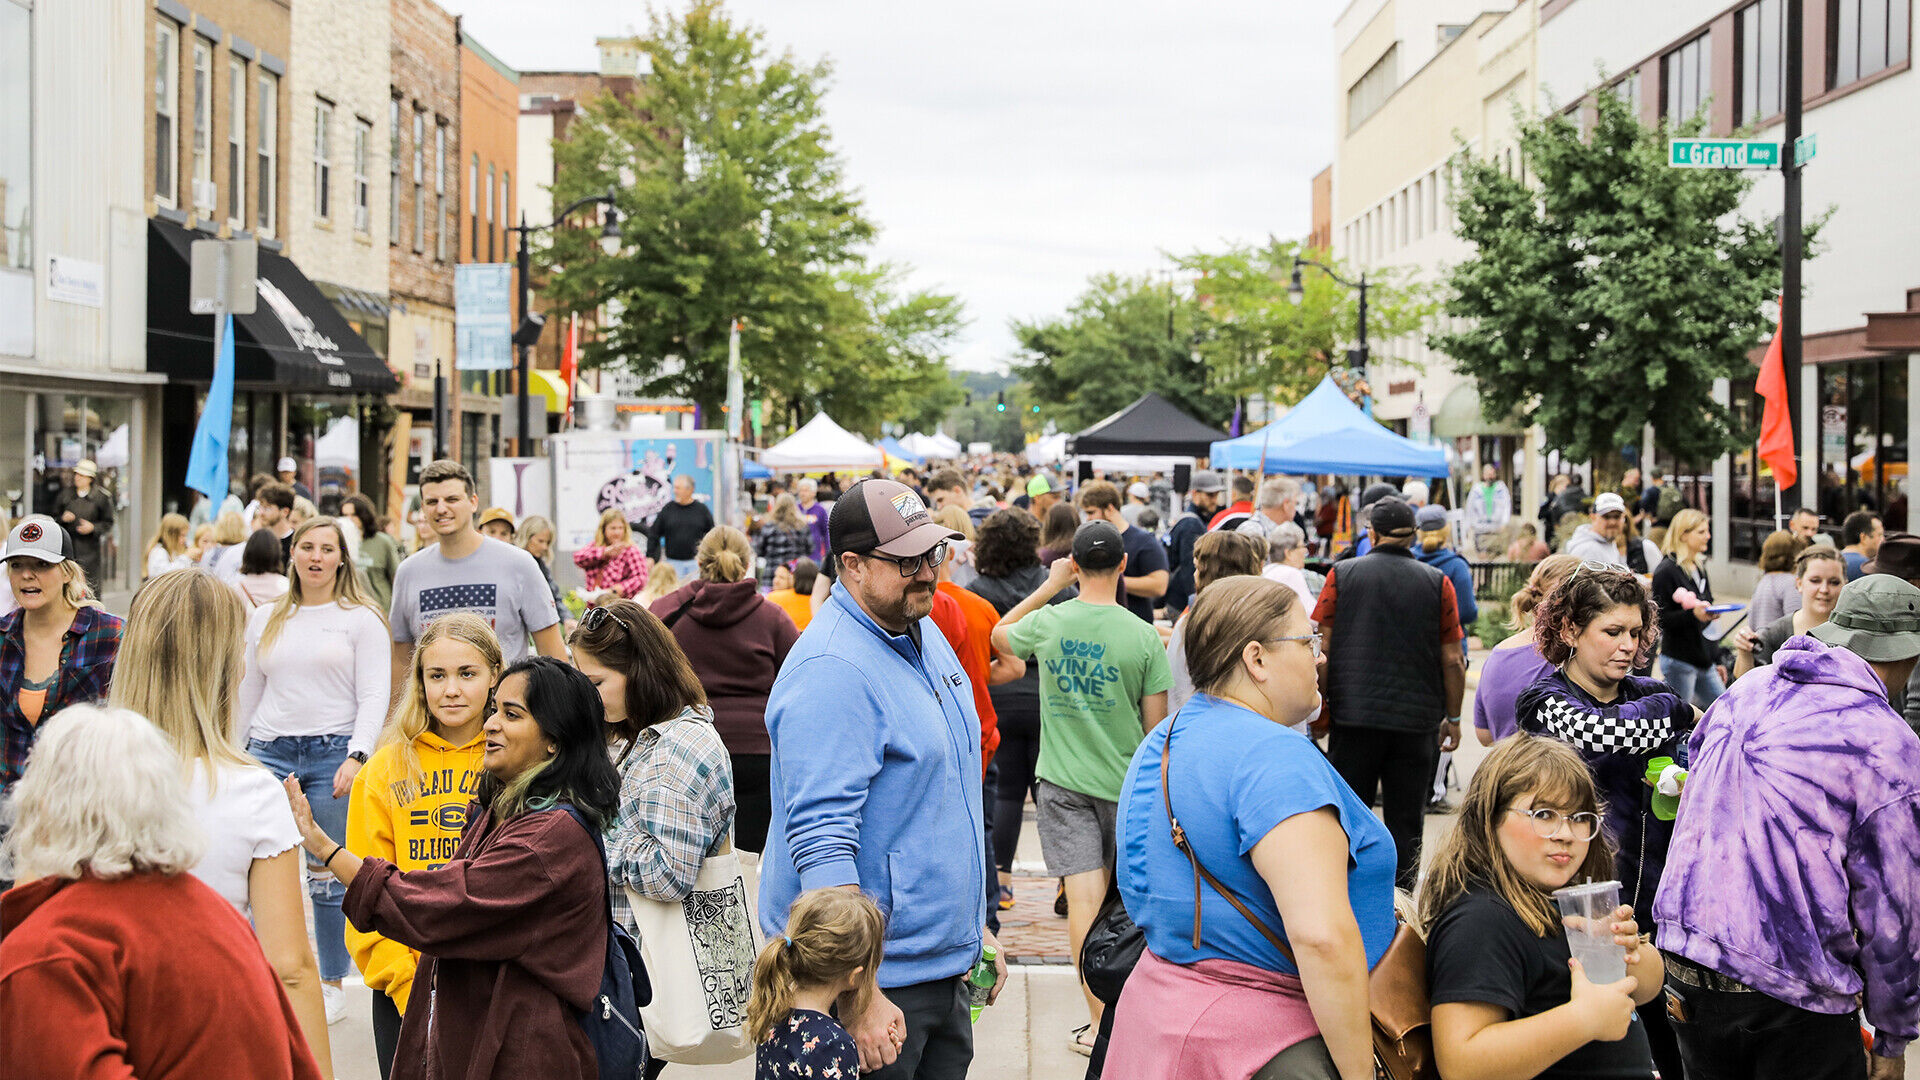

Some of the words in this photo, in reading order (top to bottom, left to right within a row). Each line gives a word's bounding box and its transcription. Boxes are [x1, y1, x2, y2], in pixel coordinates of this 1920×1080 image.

[1690, 144, 1747, 165] Grand
[1751, 149, 1771, 160] Ave
[1045, 659, 1088, 676] WIN
[1090, 663, 1119, 682] AS
[1057, 675, 1105, 698] ONE
